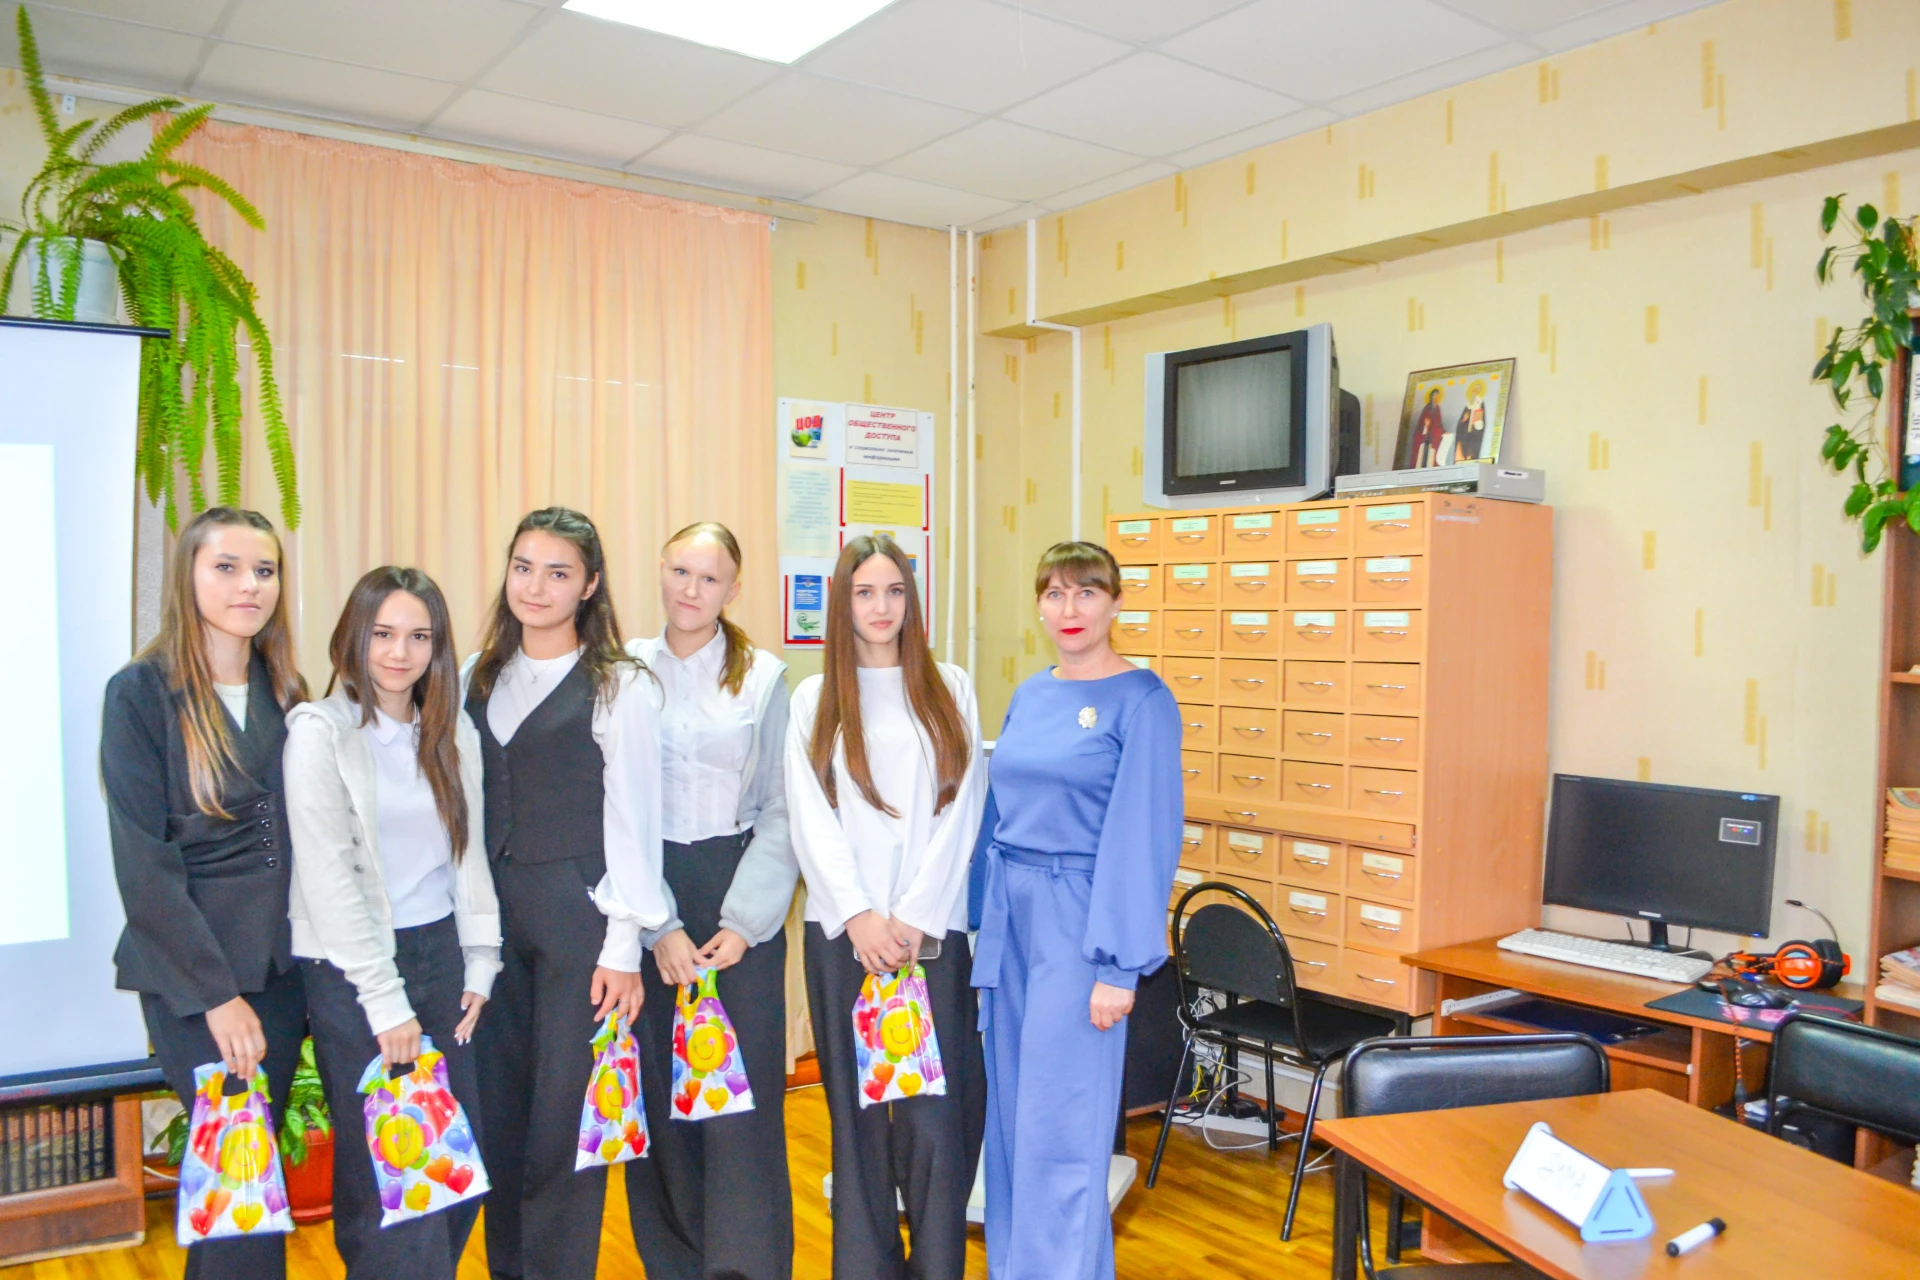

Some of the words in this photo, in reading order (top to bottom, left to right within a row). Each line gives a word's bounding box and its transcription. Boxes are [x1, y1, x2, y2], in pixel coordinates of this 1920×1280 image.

[796, 415, 822, 431] ЦОД
[848, 419, 917, 432] ОБЩЕСТВЕННОГО
[864, 432, 901, 441] ДОСТУПА
